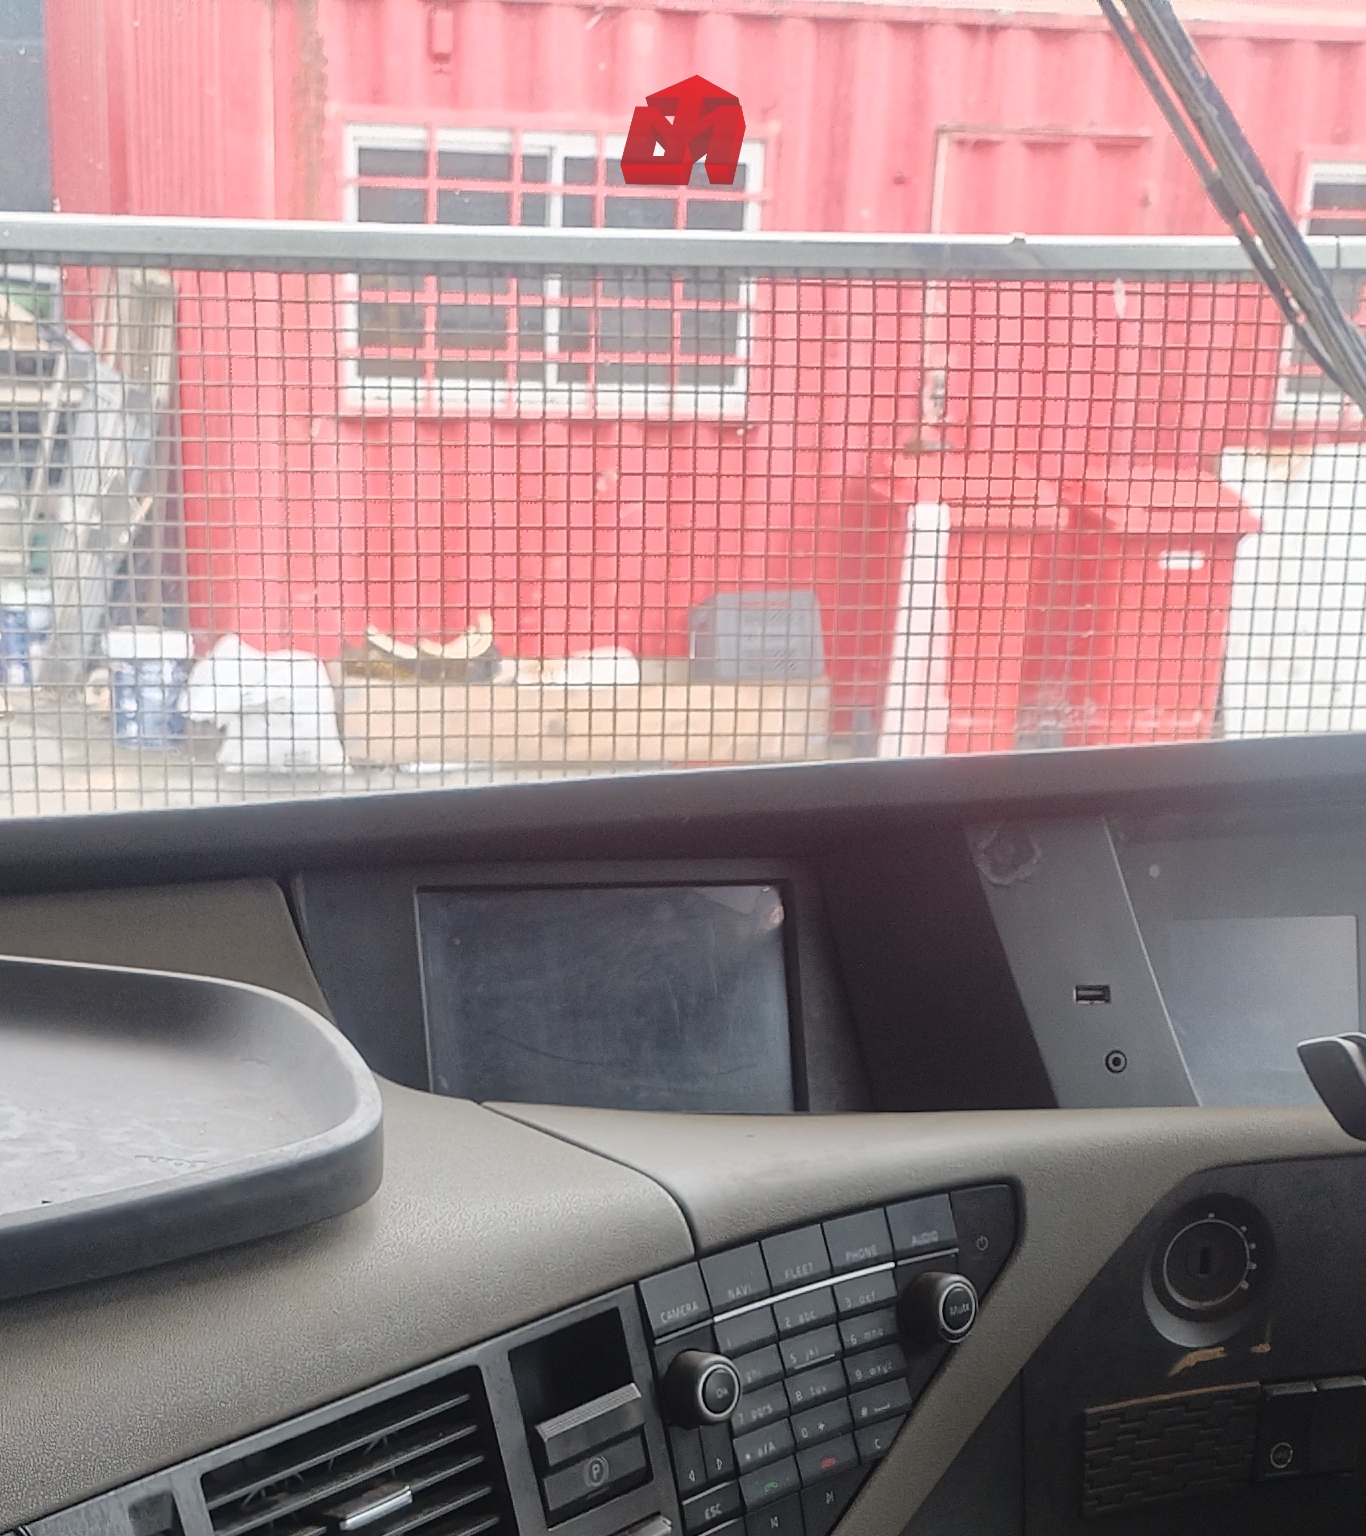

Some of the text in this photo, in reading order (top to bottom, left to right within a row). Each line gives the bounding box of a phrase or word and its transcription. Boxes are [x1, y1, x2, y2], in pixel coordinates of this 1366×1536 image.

[911, 1230, 939, 1247] AUDIO
[845, 1244, 878, 1261] PHONE
[785, 1262, 813, 1279] FLEET
[728, 1284, 752, 1299] NAVI
[660, 1301, 699, 1323] CAMERA
[949, 1303, 971, 1316] Mute
[785, 1316, 791, 1328] 2
[850, 1334, 857, 1345] 6
[855, 1369, 863, 1380] 9
[795, 1390, 803, 1401] 8
[874, 1438, 881, 1449] C
[704, 1503, 723, 1520] ESC
